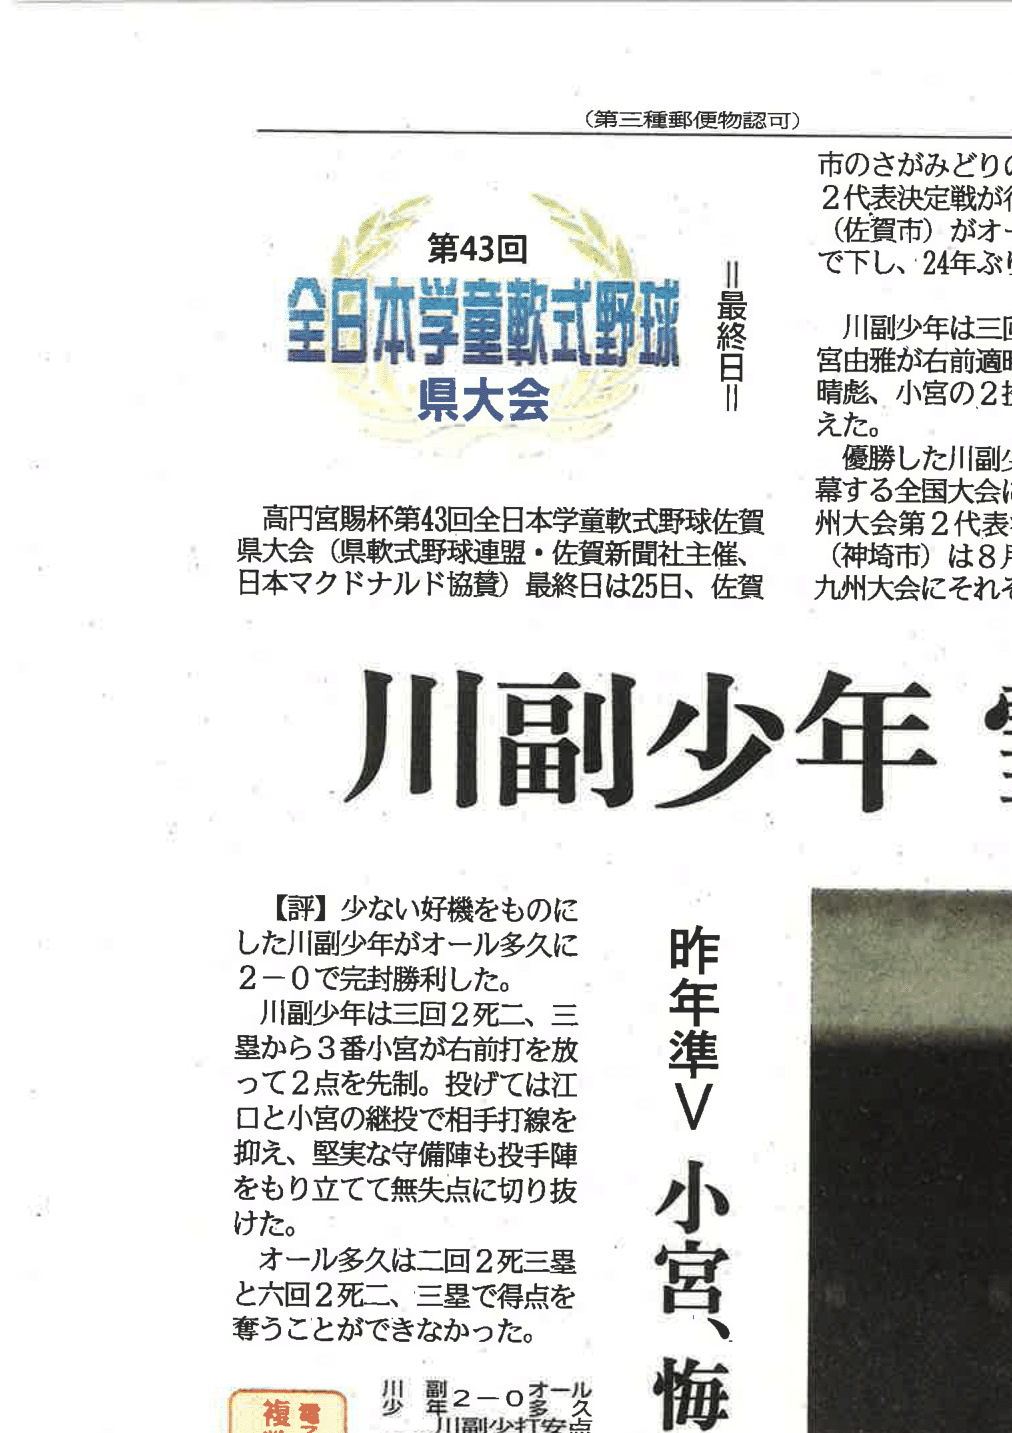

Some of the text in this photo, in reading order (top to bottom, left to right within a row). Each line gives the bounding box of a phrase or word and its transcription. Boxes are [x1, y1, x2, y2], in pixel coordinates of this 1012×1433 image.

[586, 110, 799, 129] （第三種郵便物認可）
[428, 232, 526, 264] 第43回
[287, 276, 680, 367] 全日本学童軟式野球
[418, 377, 550, 422] 県大会
[818, 411, 878, 437] えた。
[263, 504, 764, 535] 高円宮賜杯第43回全日本学童軟式野球佐賀
[237, 537, 746, 567] 県大会（県軟式野球連盟・佐賀新聞社主催、
[240, 569, 764, 600] 日本マクドナルド協賛）最終日は25日、佐賀
[344, 670, 937, 813] 川副少年
[277, 894, 578, 922] 【評】少ない好機をものに
[239, 930, 578, 958] した川副少年がオール多久に
[260, 1000, 578, 1027] 川副少年は三回2死二、三
[234, 1035, 578, 1062] 塁から3番小宮が右前打を放
[238, 1070, 577, 1098] って2点を先制。投げては江
[238, 1104, 576, 1133] 口と小宮の継投で相手打線を
[234, 1139, 577, 1168] 抑え、堅実な守備陣も投手陣
[234, 1175, 577, 1204] をもり立てて無失点に切り抜
[234, 1210, 294, 1236] けた。
[260, 1247, 576, 1274] オール多久は二回2死三塁
[236, 1281, 575, 1309] と六回2死二、三塁で得点を
[233, 1316, 532, 1343] 奪うことができなかった。
